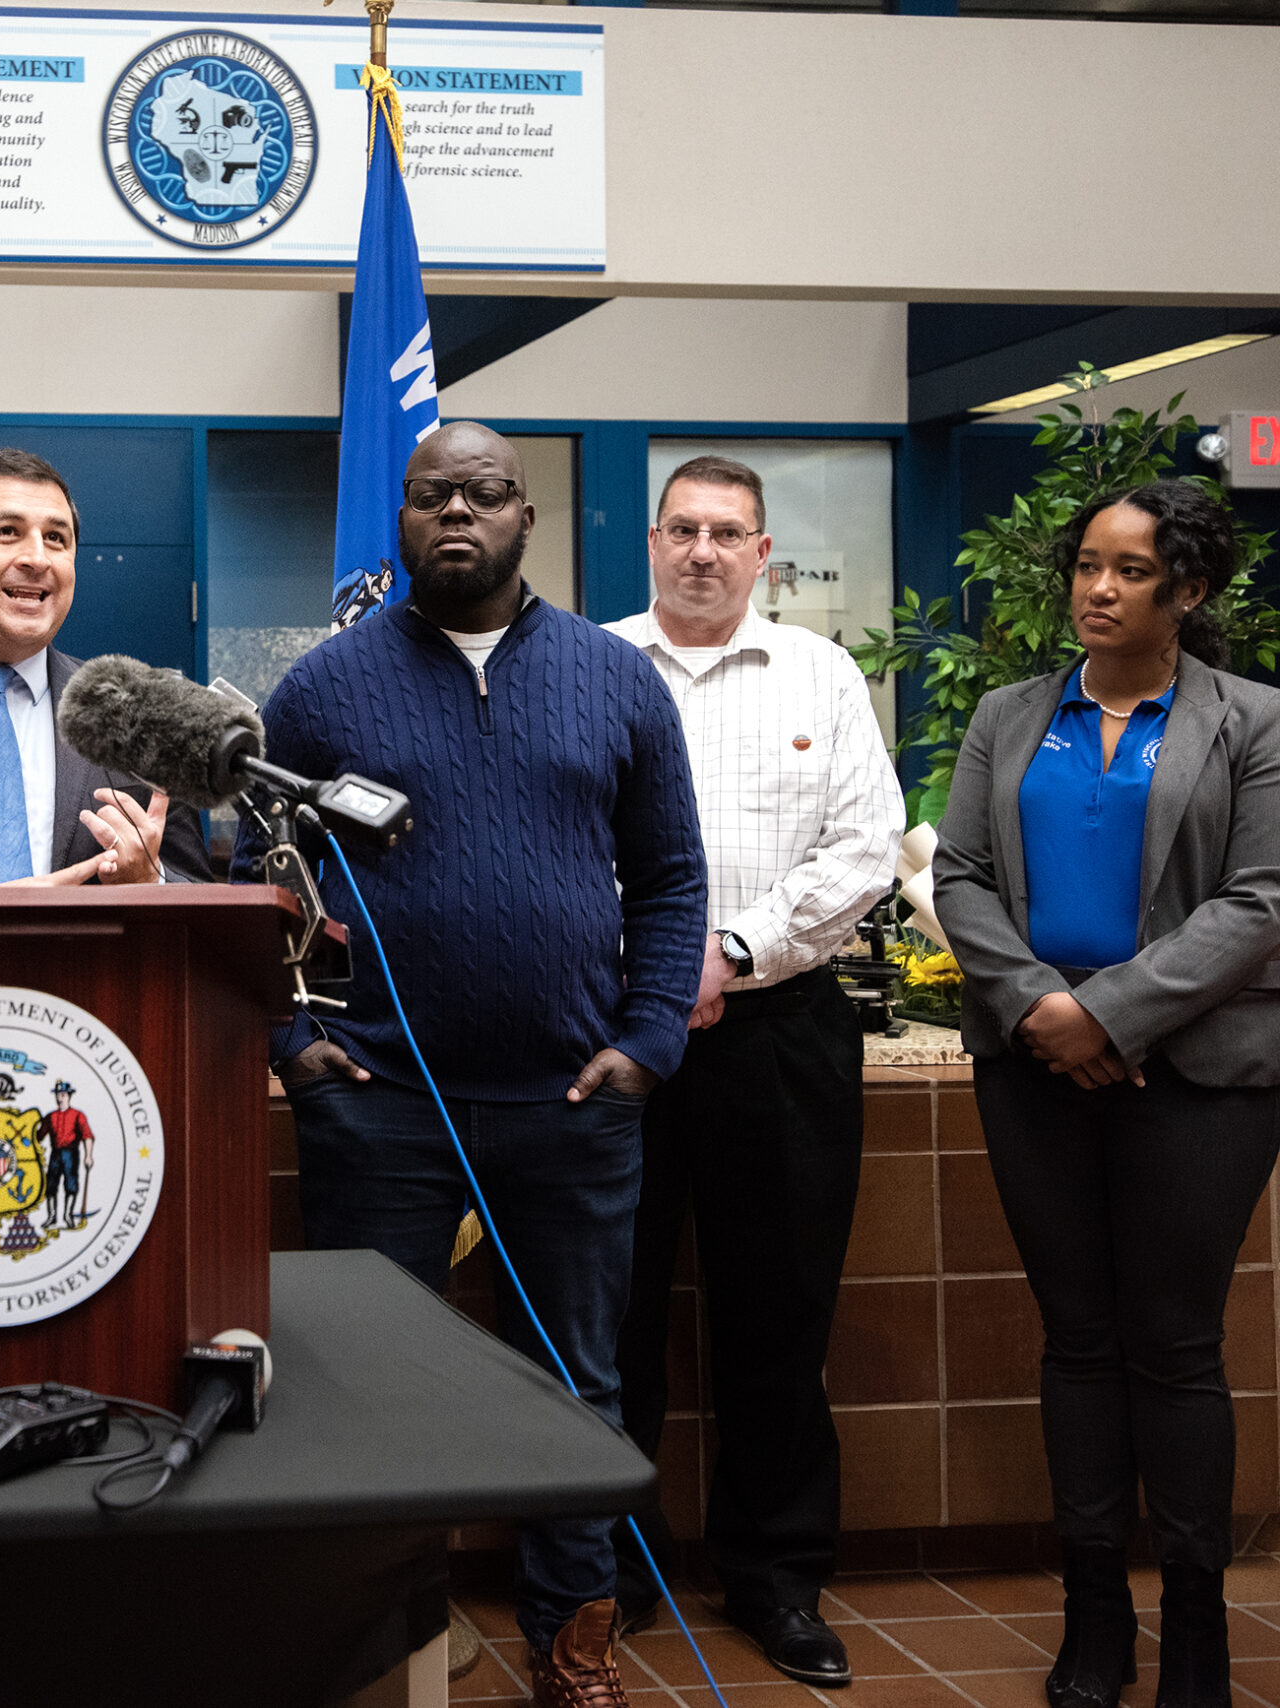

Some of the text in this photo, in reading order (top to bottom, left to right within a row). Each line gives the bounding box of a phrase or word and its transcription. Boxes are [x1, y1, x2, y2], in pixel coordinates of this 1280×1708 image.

[435, 72, 567, 91] STATEMENT
[108, 35, 313, 148] WISCONSIN STATE CRIME LABORATORY BUREAU
[15, 111, 43, 125] and
[405, 100, 535, 117] search for the truth
[425, 122, 473, 136] science
[476, 123, 502, 136] and
[506, 125, 520, 136] to
[523, 123, 552, 136] lead
[402, 141, 555, 160] hape the advancement
[413, 162, 466, 179] forensic
[471, 164, 523, 178] science.
[114, 161, 147, 205] WAUSAU
[268, 157, 310, 216] MILWAUKEE
[193, 223, 240, 242] MADISON
[75, 1026, 105, 1051] OF
[94, 1050, 151, 1138] JUSTICE
[93, 1171, 153, 1270] GENERAL
